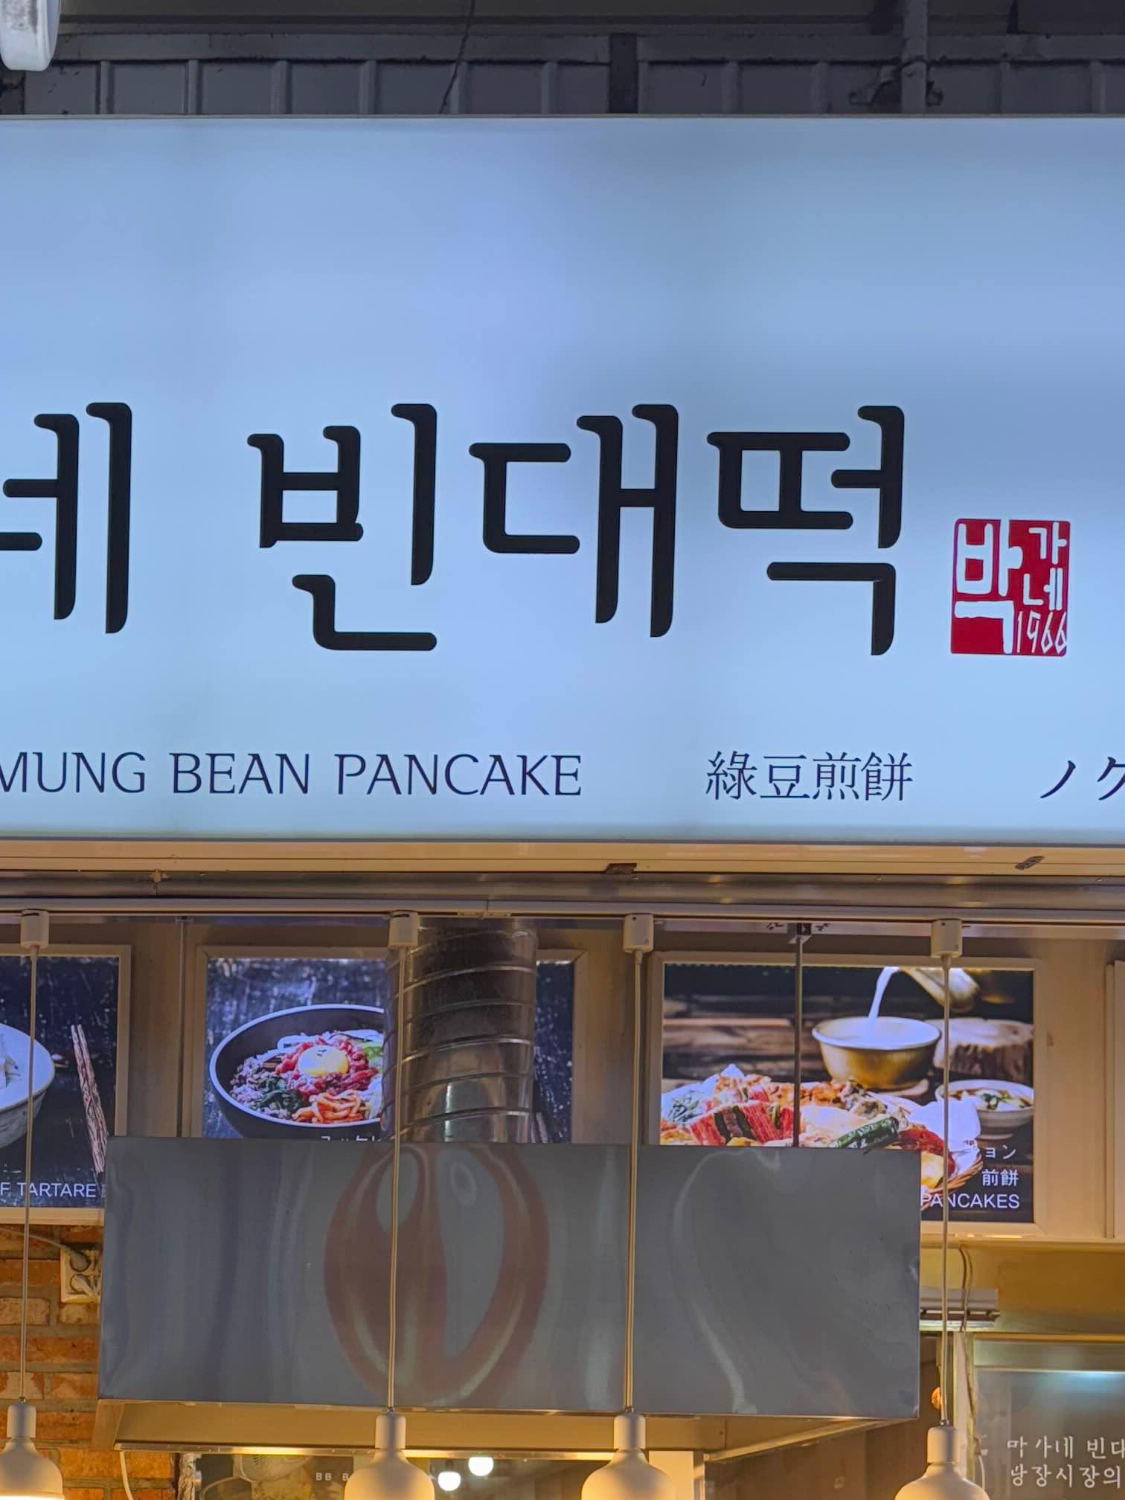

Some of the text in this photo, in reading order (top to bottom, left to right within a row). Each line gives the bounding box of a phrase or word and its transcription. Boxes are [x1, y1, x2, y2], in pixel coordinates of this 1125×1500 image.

[247, 404, 905, 656] 빈대떡
[1016, 610, 1067, 654] 1966
[170, 754, 312, 796] BEAN
[335, 755, 584, 798] PANCAKE
[705, 750, 914, 803] 綠豆煎餅
[17, 1182, 97, 1199] TARTARE
[920, 1192, 1021, 1209] PANCAKES
